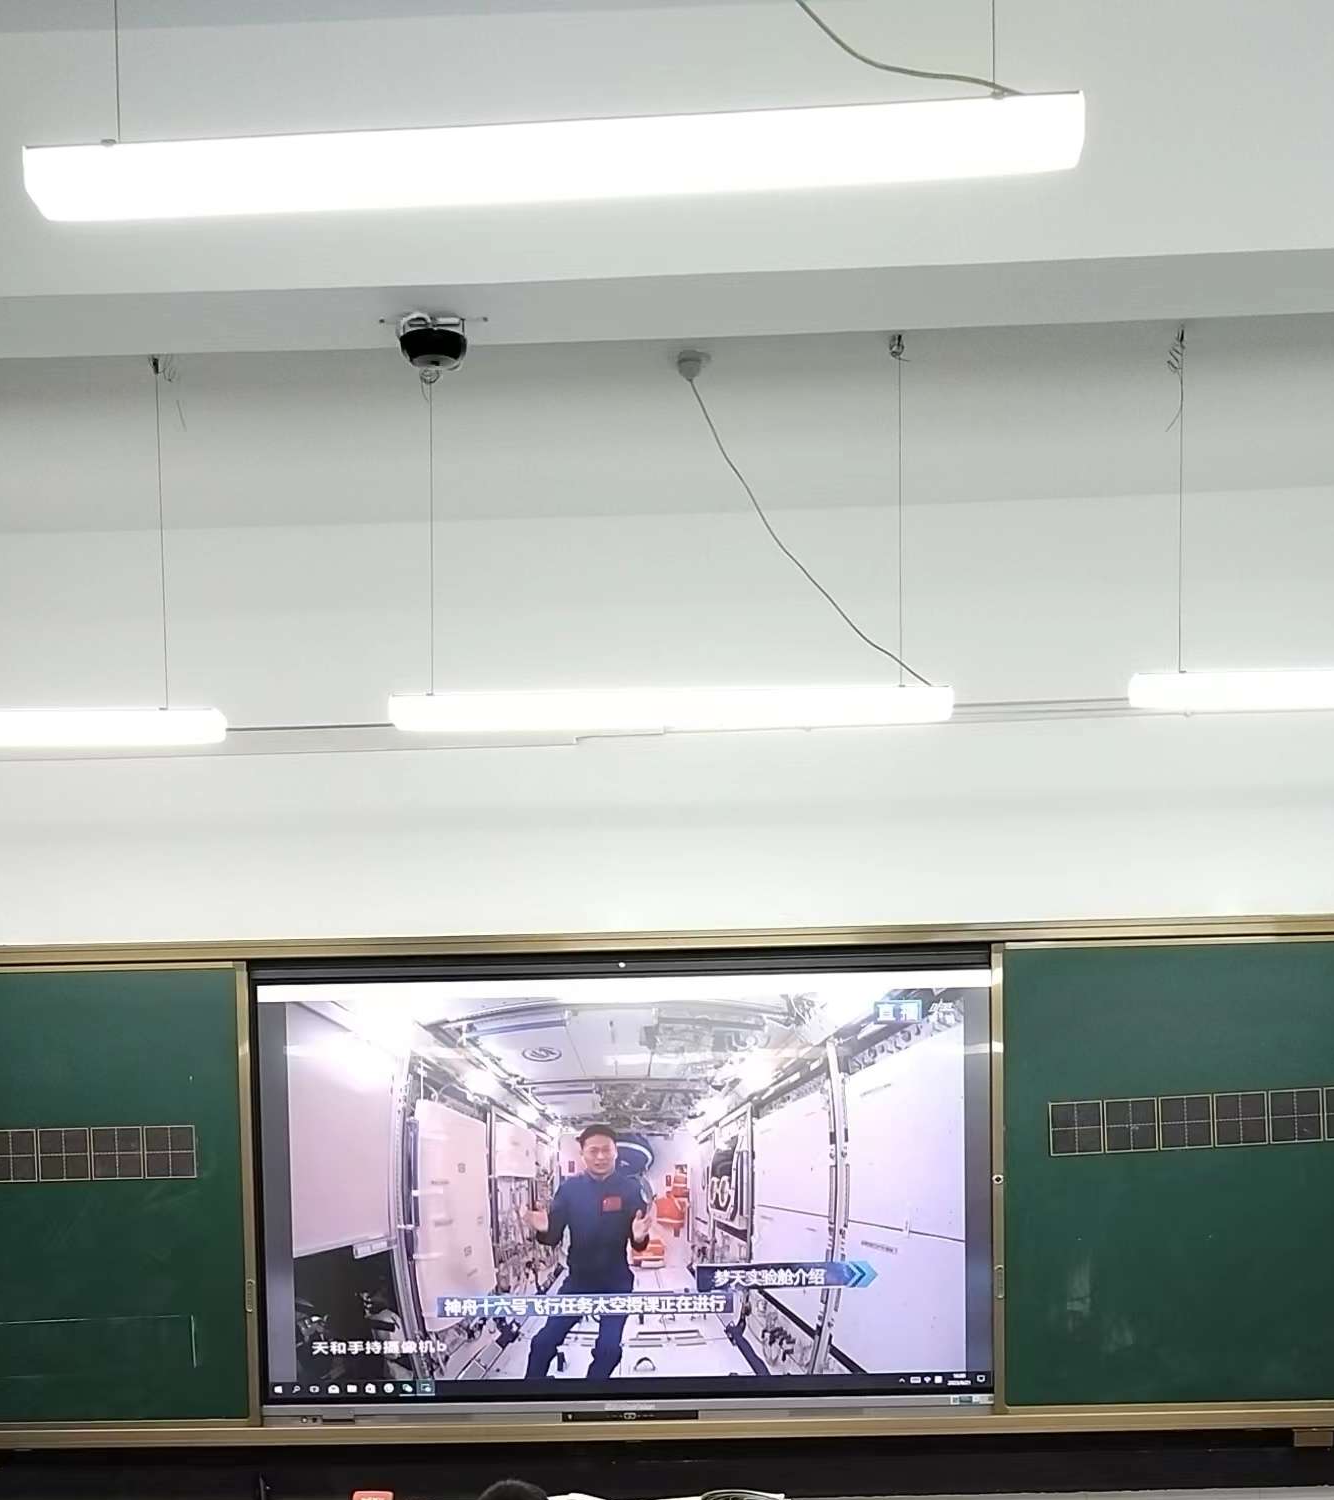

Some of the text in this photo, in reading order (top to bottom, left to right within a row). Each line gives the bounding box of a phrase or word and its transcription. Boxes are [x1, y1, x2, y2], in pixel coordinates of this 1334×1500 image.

[713, 1268, 826, 1287] 梦天实验舱介绍
[443, 1295, 727, 1315] 神舟十六号飞行任务太空授课正在进行
[311, 1340, 448, 1356] 天和手持摄像机b
